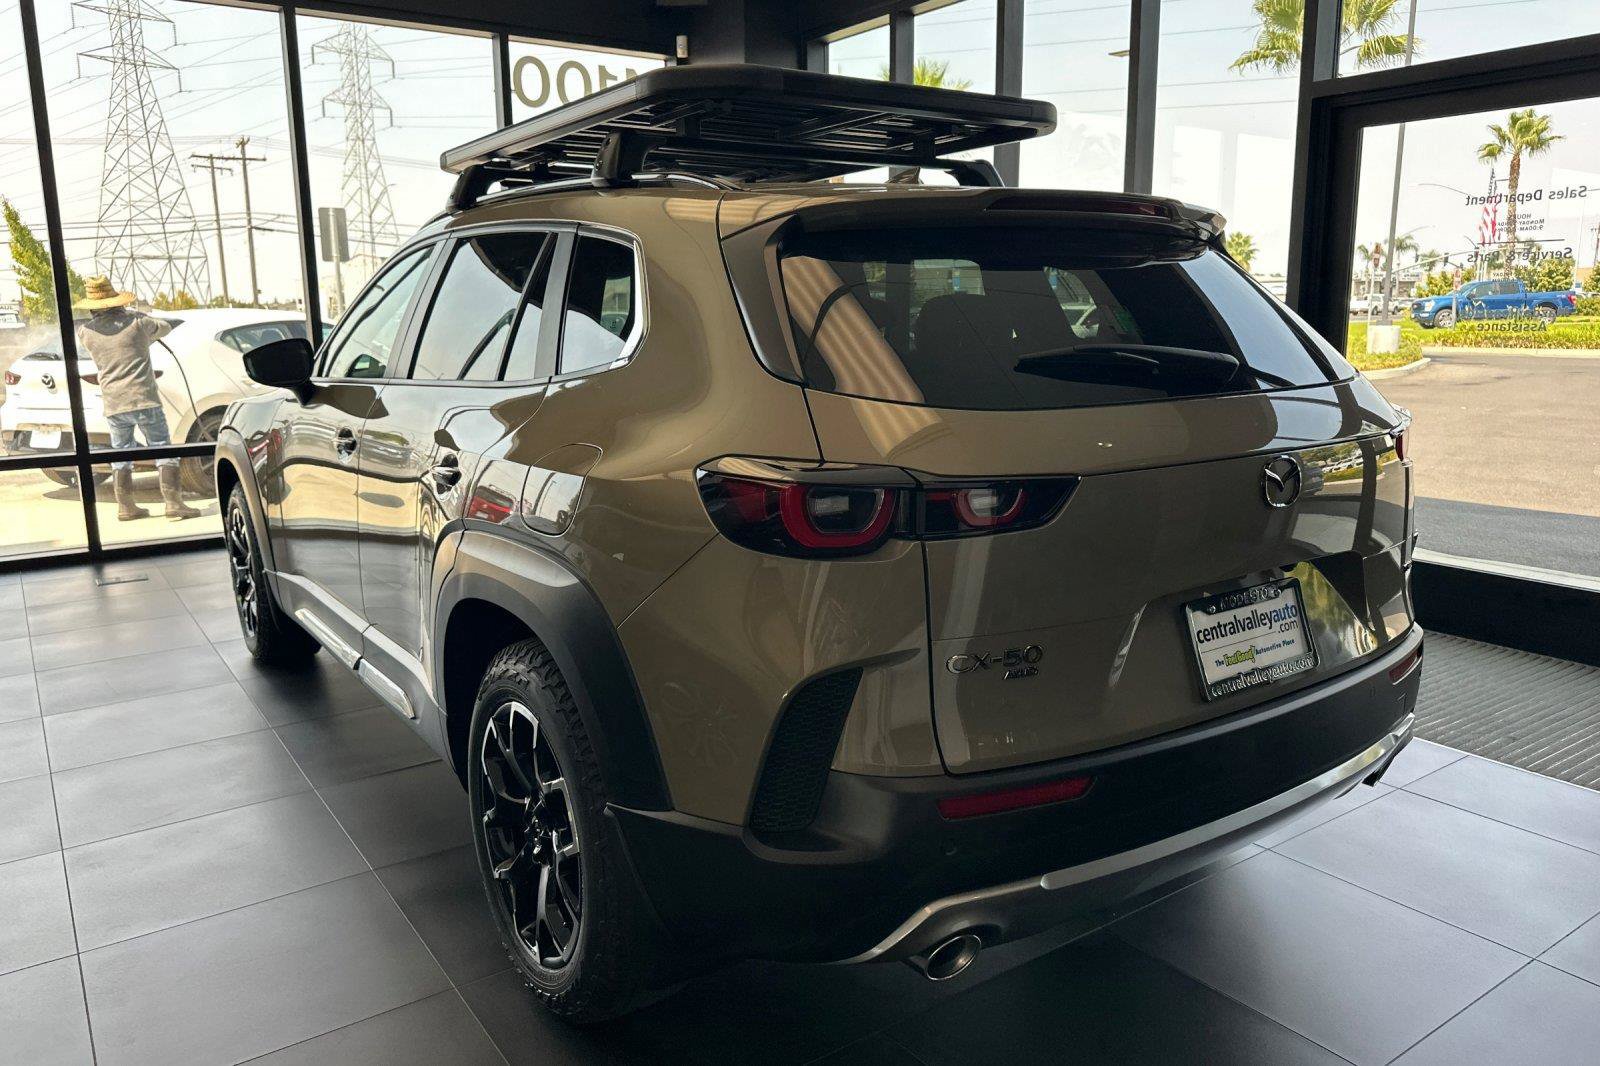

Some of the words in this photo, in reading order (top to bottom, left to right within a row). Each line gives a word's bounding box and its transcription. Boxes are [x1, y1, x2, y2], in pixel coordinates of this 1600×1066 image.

[1196, 603, 1298, 644] centralvalleyauto
[1277, 619, 1299, 634] .com
[946, 645, 1043, 674] CX-50
